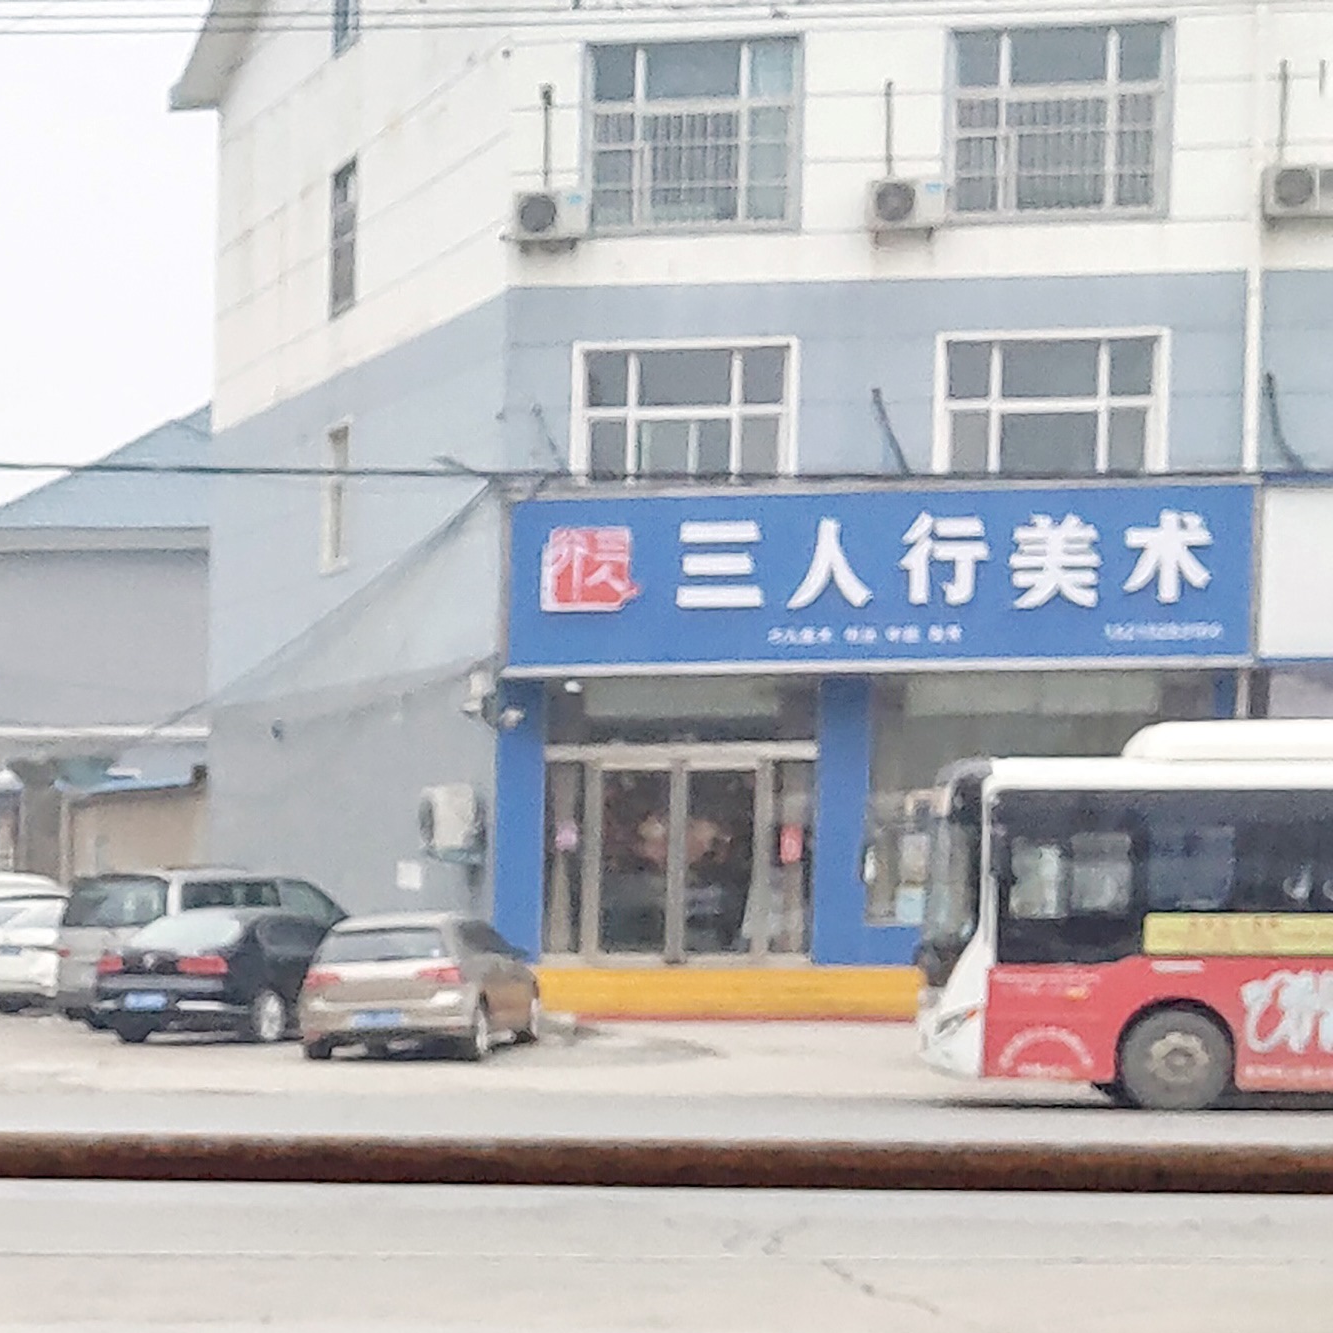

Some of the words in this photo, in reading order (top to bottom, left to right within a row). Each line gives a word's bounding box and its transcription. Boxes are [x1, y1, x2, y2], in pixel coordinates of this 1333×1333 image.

[675, 508, 1217, 610] 三人行美术
